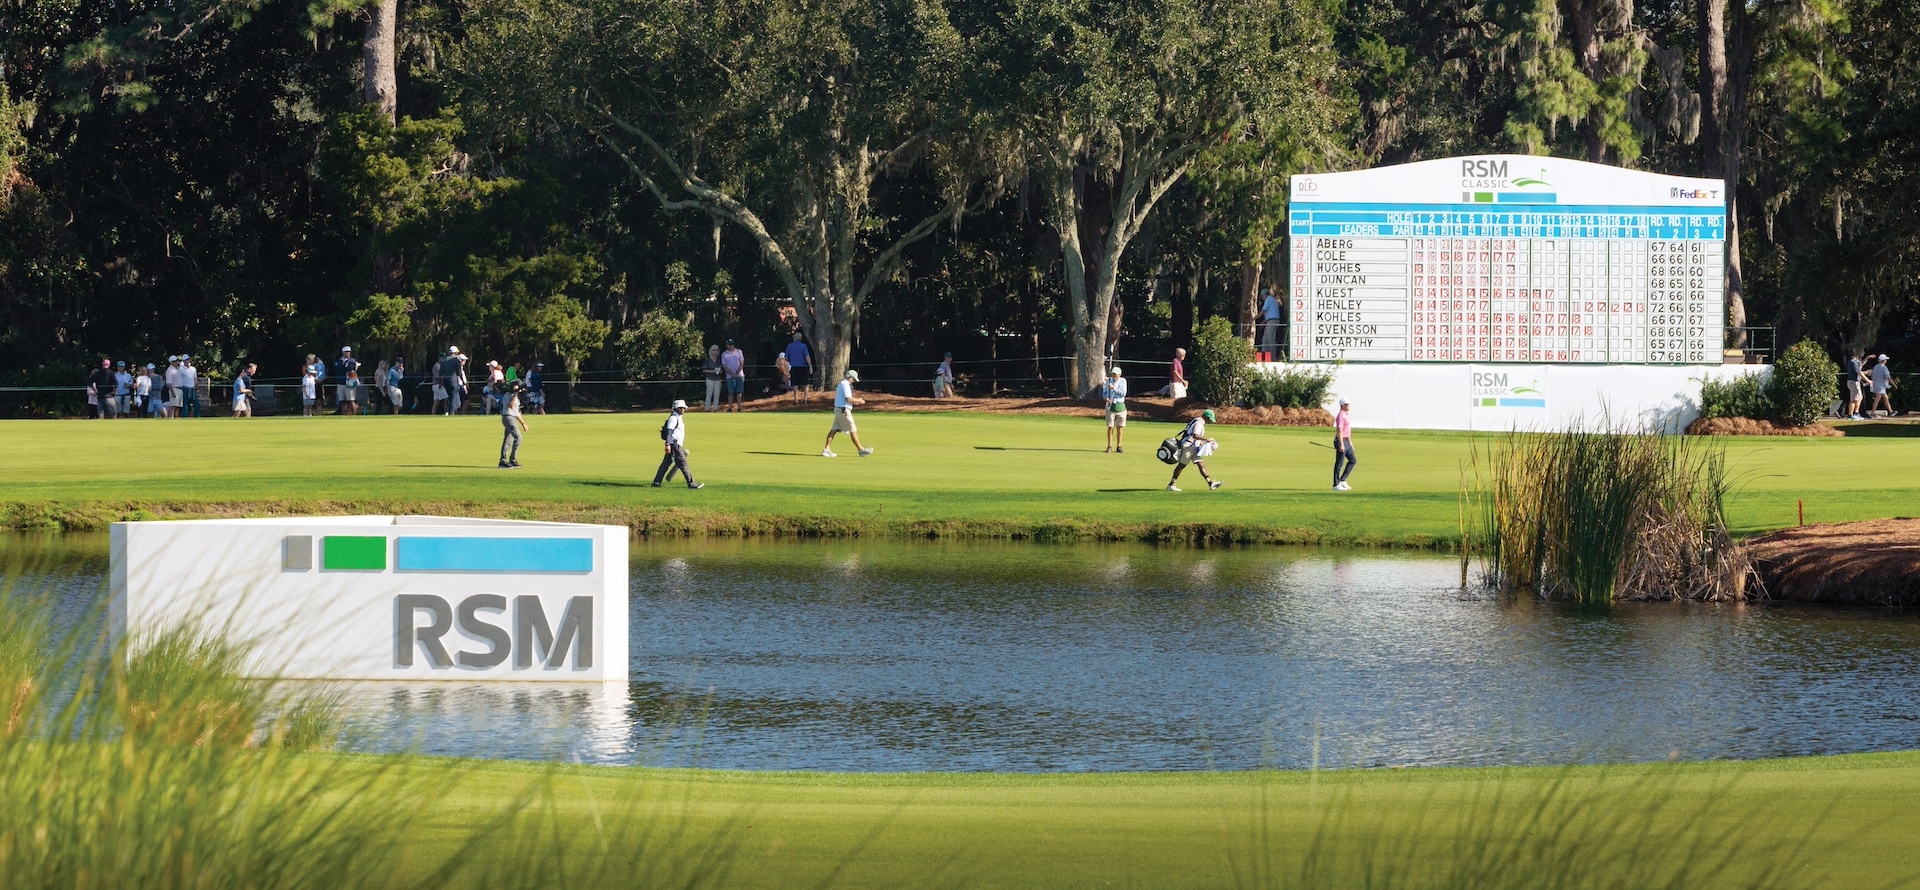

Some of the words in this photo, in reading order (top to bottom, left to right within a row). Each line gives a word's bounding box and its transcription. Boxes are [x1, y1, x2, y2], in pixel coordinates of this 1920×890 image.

[1462, 160, 1508, 178] RSM
[1462, 180, 1508, 188] CLASSIC
[1680, 190, 1707, 198] FedEx
[1387, 213, 1410, 223] HOLE
[1417, 214, 1421, 223] 1
[1429, 214, 1434, 223] 2
[1442, 214, 1447, 224] 3
[1456, 214, 1461, 224] 4
[1469, 214, 1474, 224] 5
[1482, 215, 1487, 224] 6
[1495, 215, 1500, 224] 7
[1508, 215, 1514, 224] 8
[1521, 215, 1526, 224] 9
[1533, 215, 1542, 224] 10
[1546, 215, 1554, 225] 11
[1559, 216, 1568, 225] 12
[1572, 216, 1581, 225] 13
[1585, 216, 1594, 225] 14
[1598, 216, 1606, 225] 15
[1611, 216, 1620, 225] 16
[1624, 216, 1633, 225] 17
[1637, 216, 1646, 226] 18
[1650, 217, 1664, 226] RD.
[1669, 217, 1682, 227] RD.
[1690, 217, 1703, 227] RD.
[1708, 217, 1722, 227] RD.
[1340, 225, 1379, 235] LEADERS
[1393, 226, 1410, 235] PAR
[1656, 229, 1660, 238] 1
[1673, 229, 1678, 238] 2
[1694, 229, 1700, 238] 3
[1712, 229, 1717, 238] 4
[1297, 239, 1304, 248] 20
[1317, 239, 1353, 248] ABERG
[1652, 242, 1665, 252] 67
[1670, 243, 1684, 252] 64
[1692, 242, 1701, 252] 61
[1297, 250, 1303, 259] 19
[1317, 251, 1346, 260] COLE
[1652, 254, 1665, 264] 66
[1670, 255, 1682, 264] 66
[1692, 255, 1702, 264] 61
[1296, 263, 1304, 272] 18
[1317, 263, 1360, 272] HUGHES
[1652, 267, 1664, 276] 68
[1670, 267, 1683, 276] 66
[1690, 267, 1703, 276] 60
[1296, 276, 1304, 285] 17
[1321, 276, 1366, 284] DUNCAN
[1652, 279, 1664, 288] 68
[1670, 279, 1683, 288] 65
[1690, 279, 1703, 288] 62
[1296, 288, 1303, 297] 13
[1317, 288, 1353, 297] KUEST
[1651, 291, 1664, 300] 67
[1670, 291, 1682, 300] 66
[1691, 291, 1704, 300] 66
[1297, 300, 1303, 309] 9
[1319, 300, 1362, 309] HENLEY
[1651, 304, 1664, 312] 72
[1670, 303, 1683, 312] 66
[1690, 303, 1702, 312] 65
[1296, 312, 1304, 321] 12
[1318, 312, 1361, 321] KOHLES
[1652, 315, 1665, 324] 66
[1670, 315, 1683, 324] 67
[1690, 315, 1702, 324] 67
[1318, 325, 1376, 334] SVENSSON
[1651, 328, 1664, 336] 68
[1669, 328, 1682, 336] 66
[1690, 328, 1704, 336] 67
[1316, 337, 1373, 346] MCCARTHY
[1651, 340, 1665, 349] 65
[1670, 340, 1683, 349] 67
[1690, 340, 1703, 349] 66
[1296, 349, 1304, 358] 14
[1320, 349, 1345, 358] LIST
[1651, 352, 1664, 361] 67
[1669, 352, 1682, 361] 68
[1690, 352, 1703, 361] 66
[1473, 373, 1507, 386] RSM
[398, 594, 594, 668] RSM
